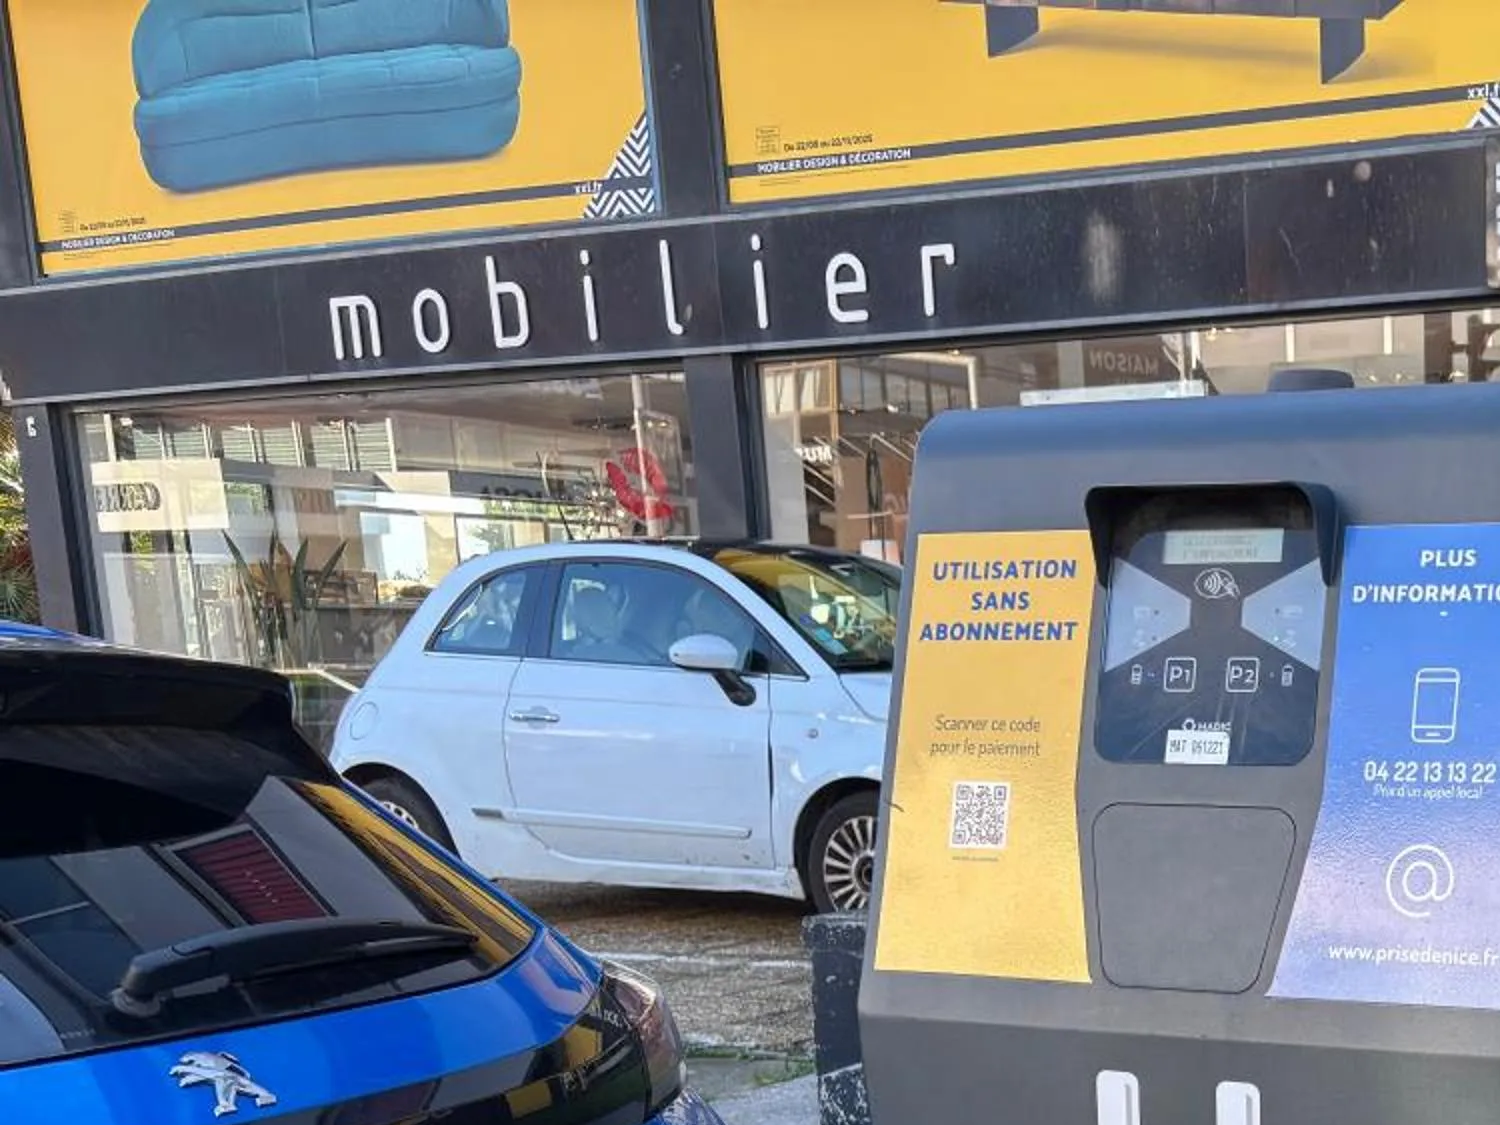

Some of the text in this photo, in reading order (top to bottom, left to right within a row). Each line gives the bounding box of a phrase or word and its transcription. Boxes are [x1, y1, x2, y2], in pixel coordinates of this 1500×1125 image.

[757, 159, 801, 174] MOBILIER
[803, 156, 838, 169] DESIGN
[329, 233, 955, 361] mobilier
[1420, 549, 1478, 568] PLUS
[932, 559, 1077, 581] UTILISATION
[971, 591, 1031, 611] SANS
[919, 621, 1079, 642] ABONNEMENT
[1169, 665, 1190, 684] P1
[1229, 665, 1256, 684] P2
[935, 713, 1041, 733] Scanner ce code
[929, 737, 1041, 758] pour le paiement
[1364, 760, 1497, 784] 04 22 13 13 22
[1456, 785, 1483, 800] local
[1328, 944, 1500, 968] www.prisedenice.fr
